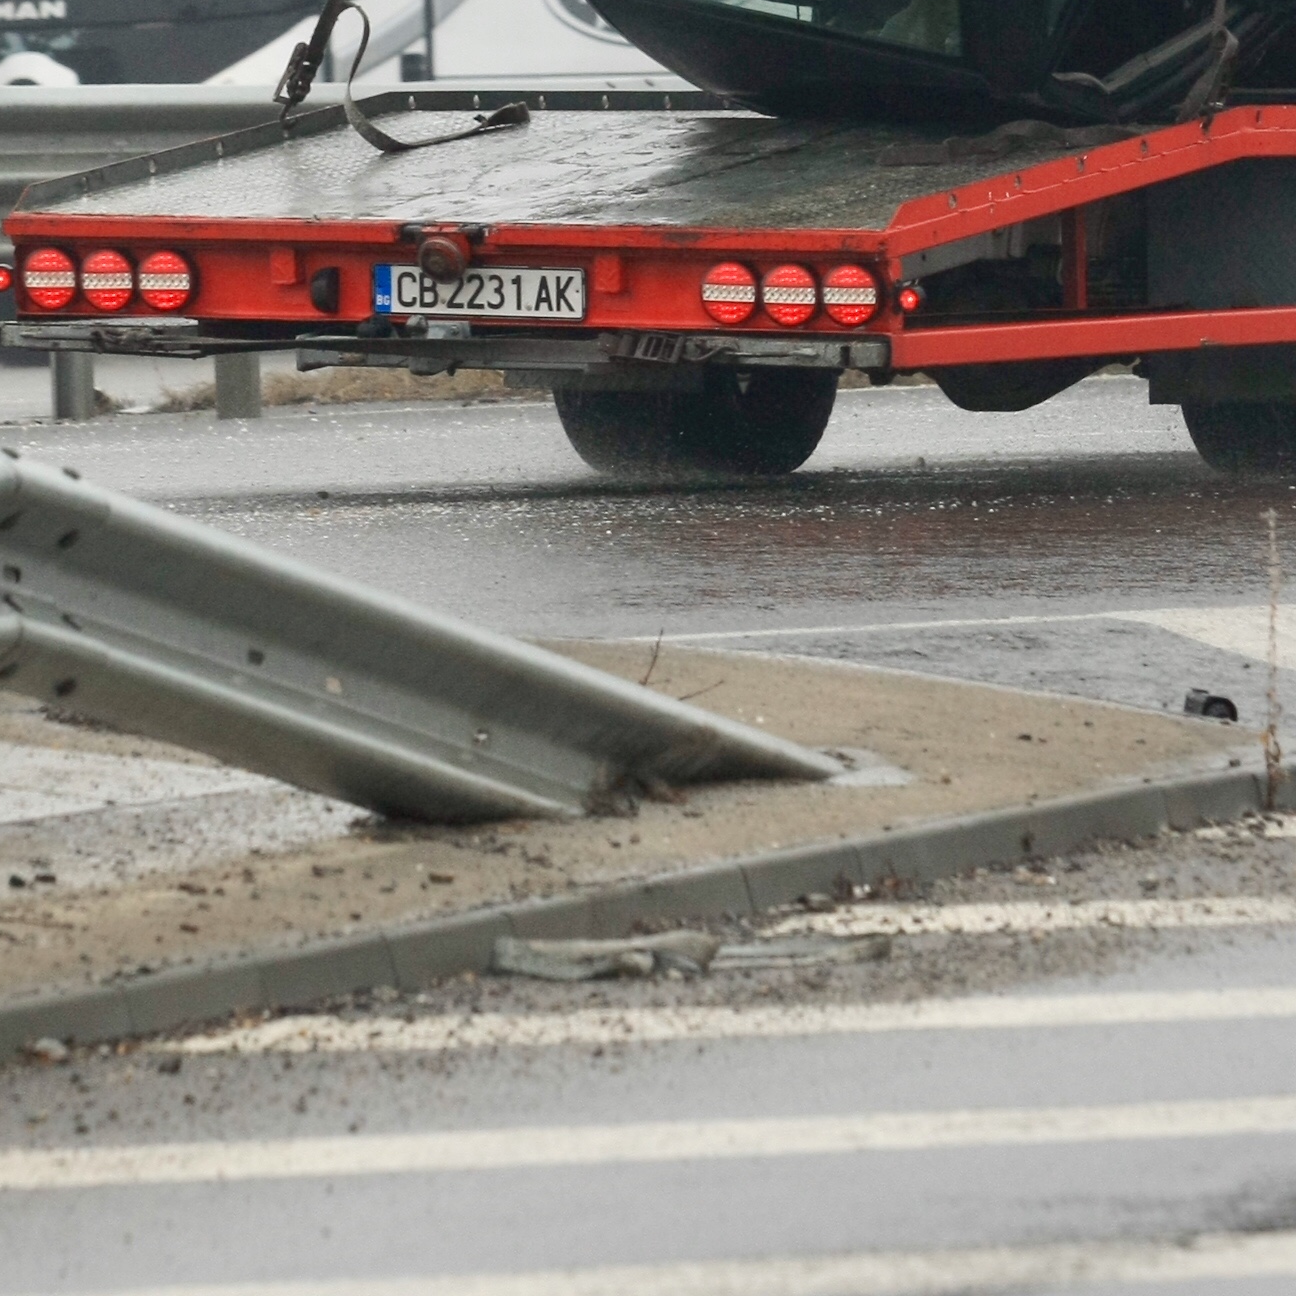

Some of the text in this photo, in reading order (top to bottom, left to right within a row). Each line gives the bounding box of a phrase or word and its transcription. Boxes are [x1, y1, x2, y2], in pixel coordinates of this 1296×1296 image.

[376, 294, 390, 306] BG
[396, 271, 576, 313] CB 2231 AK
